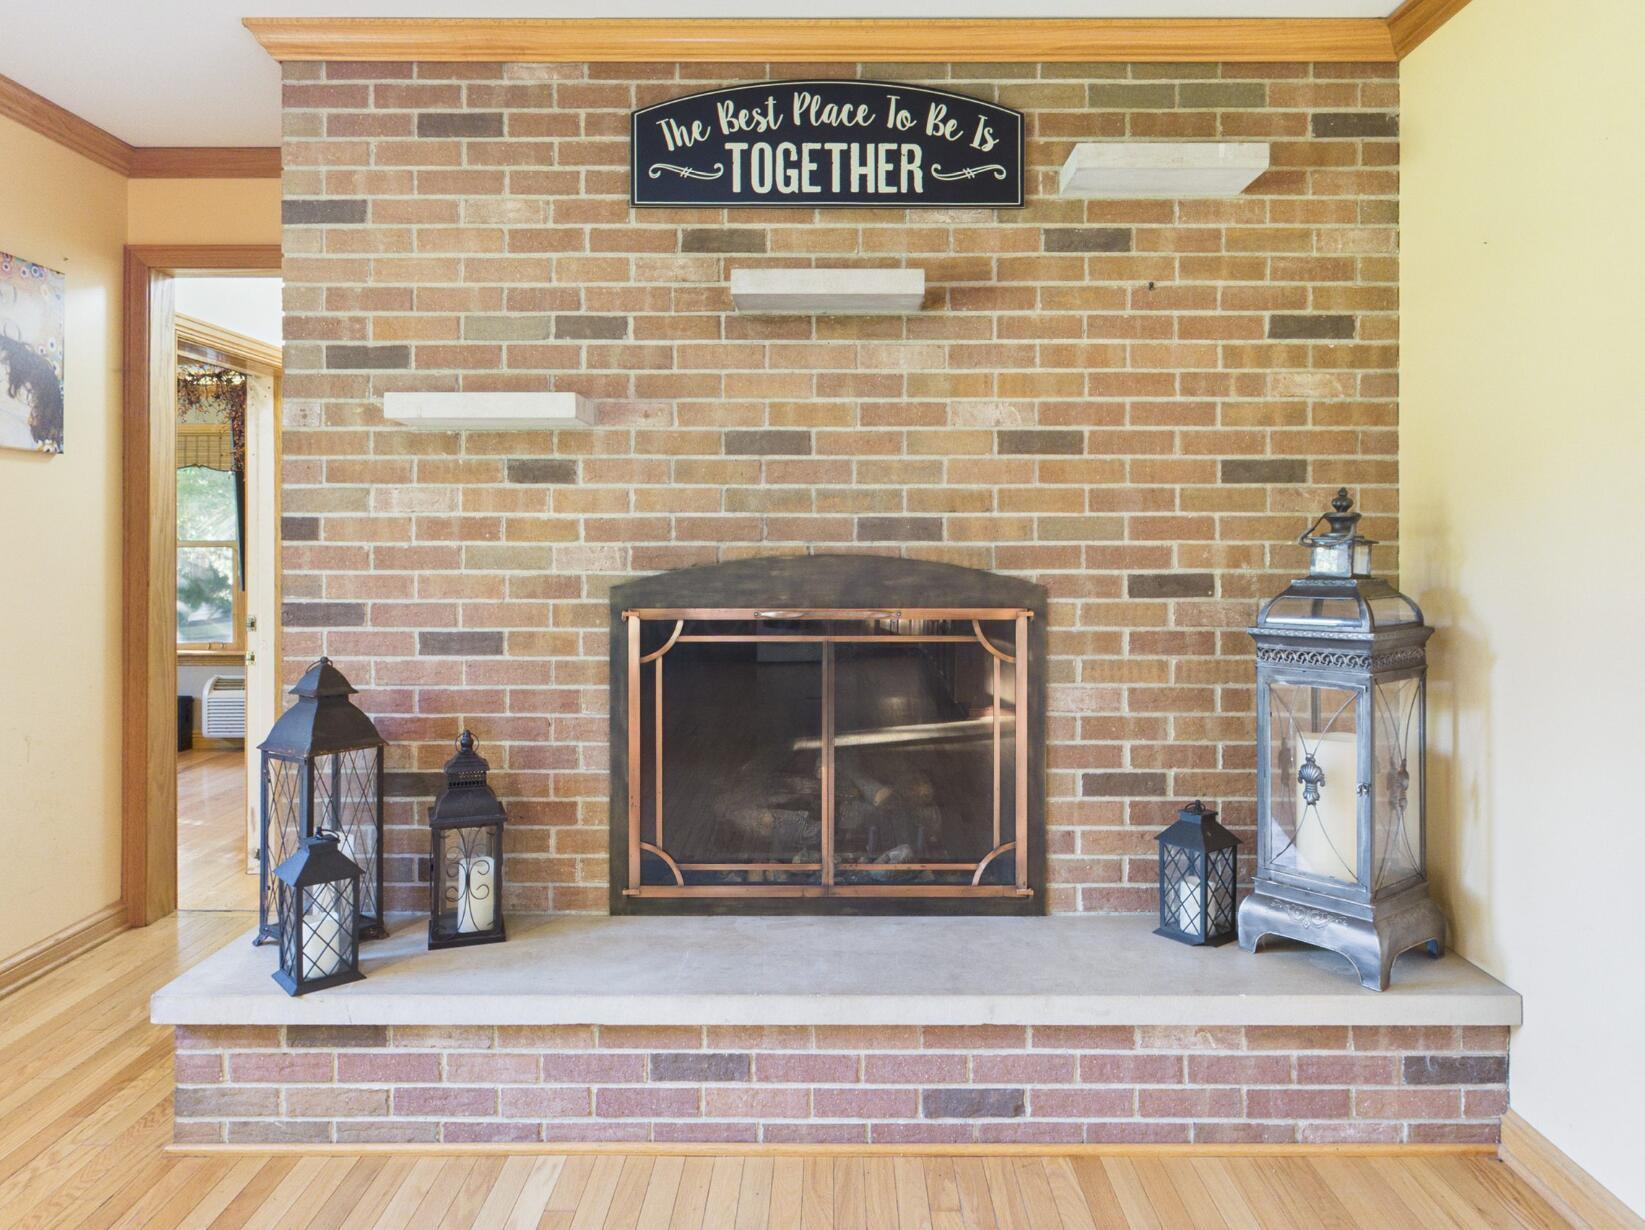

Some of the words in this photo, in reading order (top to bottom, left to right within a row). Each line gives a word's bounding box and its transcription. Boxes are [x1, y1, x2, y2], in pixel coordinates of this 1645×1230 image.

[656, 118, 711, 152] The
[717, 95, 784, 135] Best
[793, 91, 876, 127] Place
[886, 95, 917, 131] To
[926, 102, 964, 141] Be
[970, 114, 1000, 152] Is
[724, 141, 924, 194] TOGETHER
